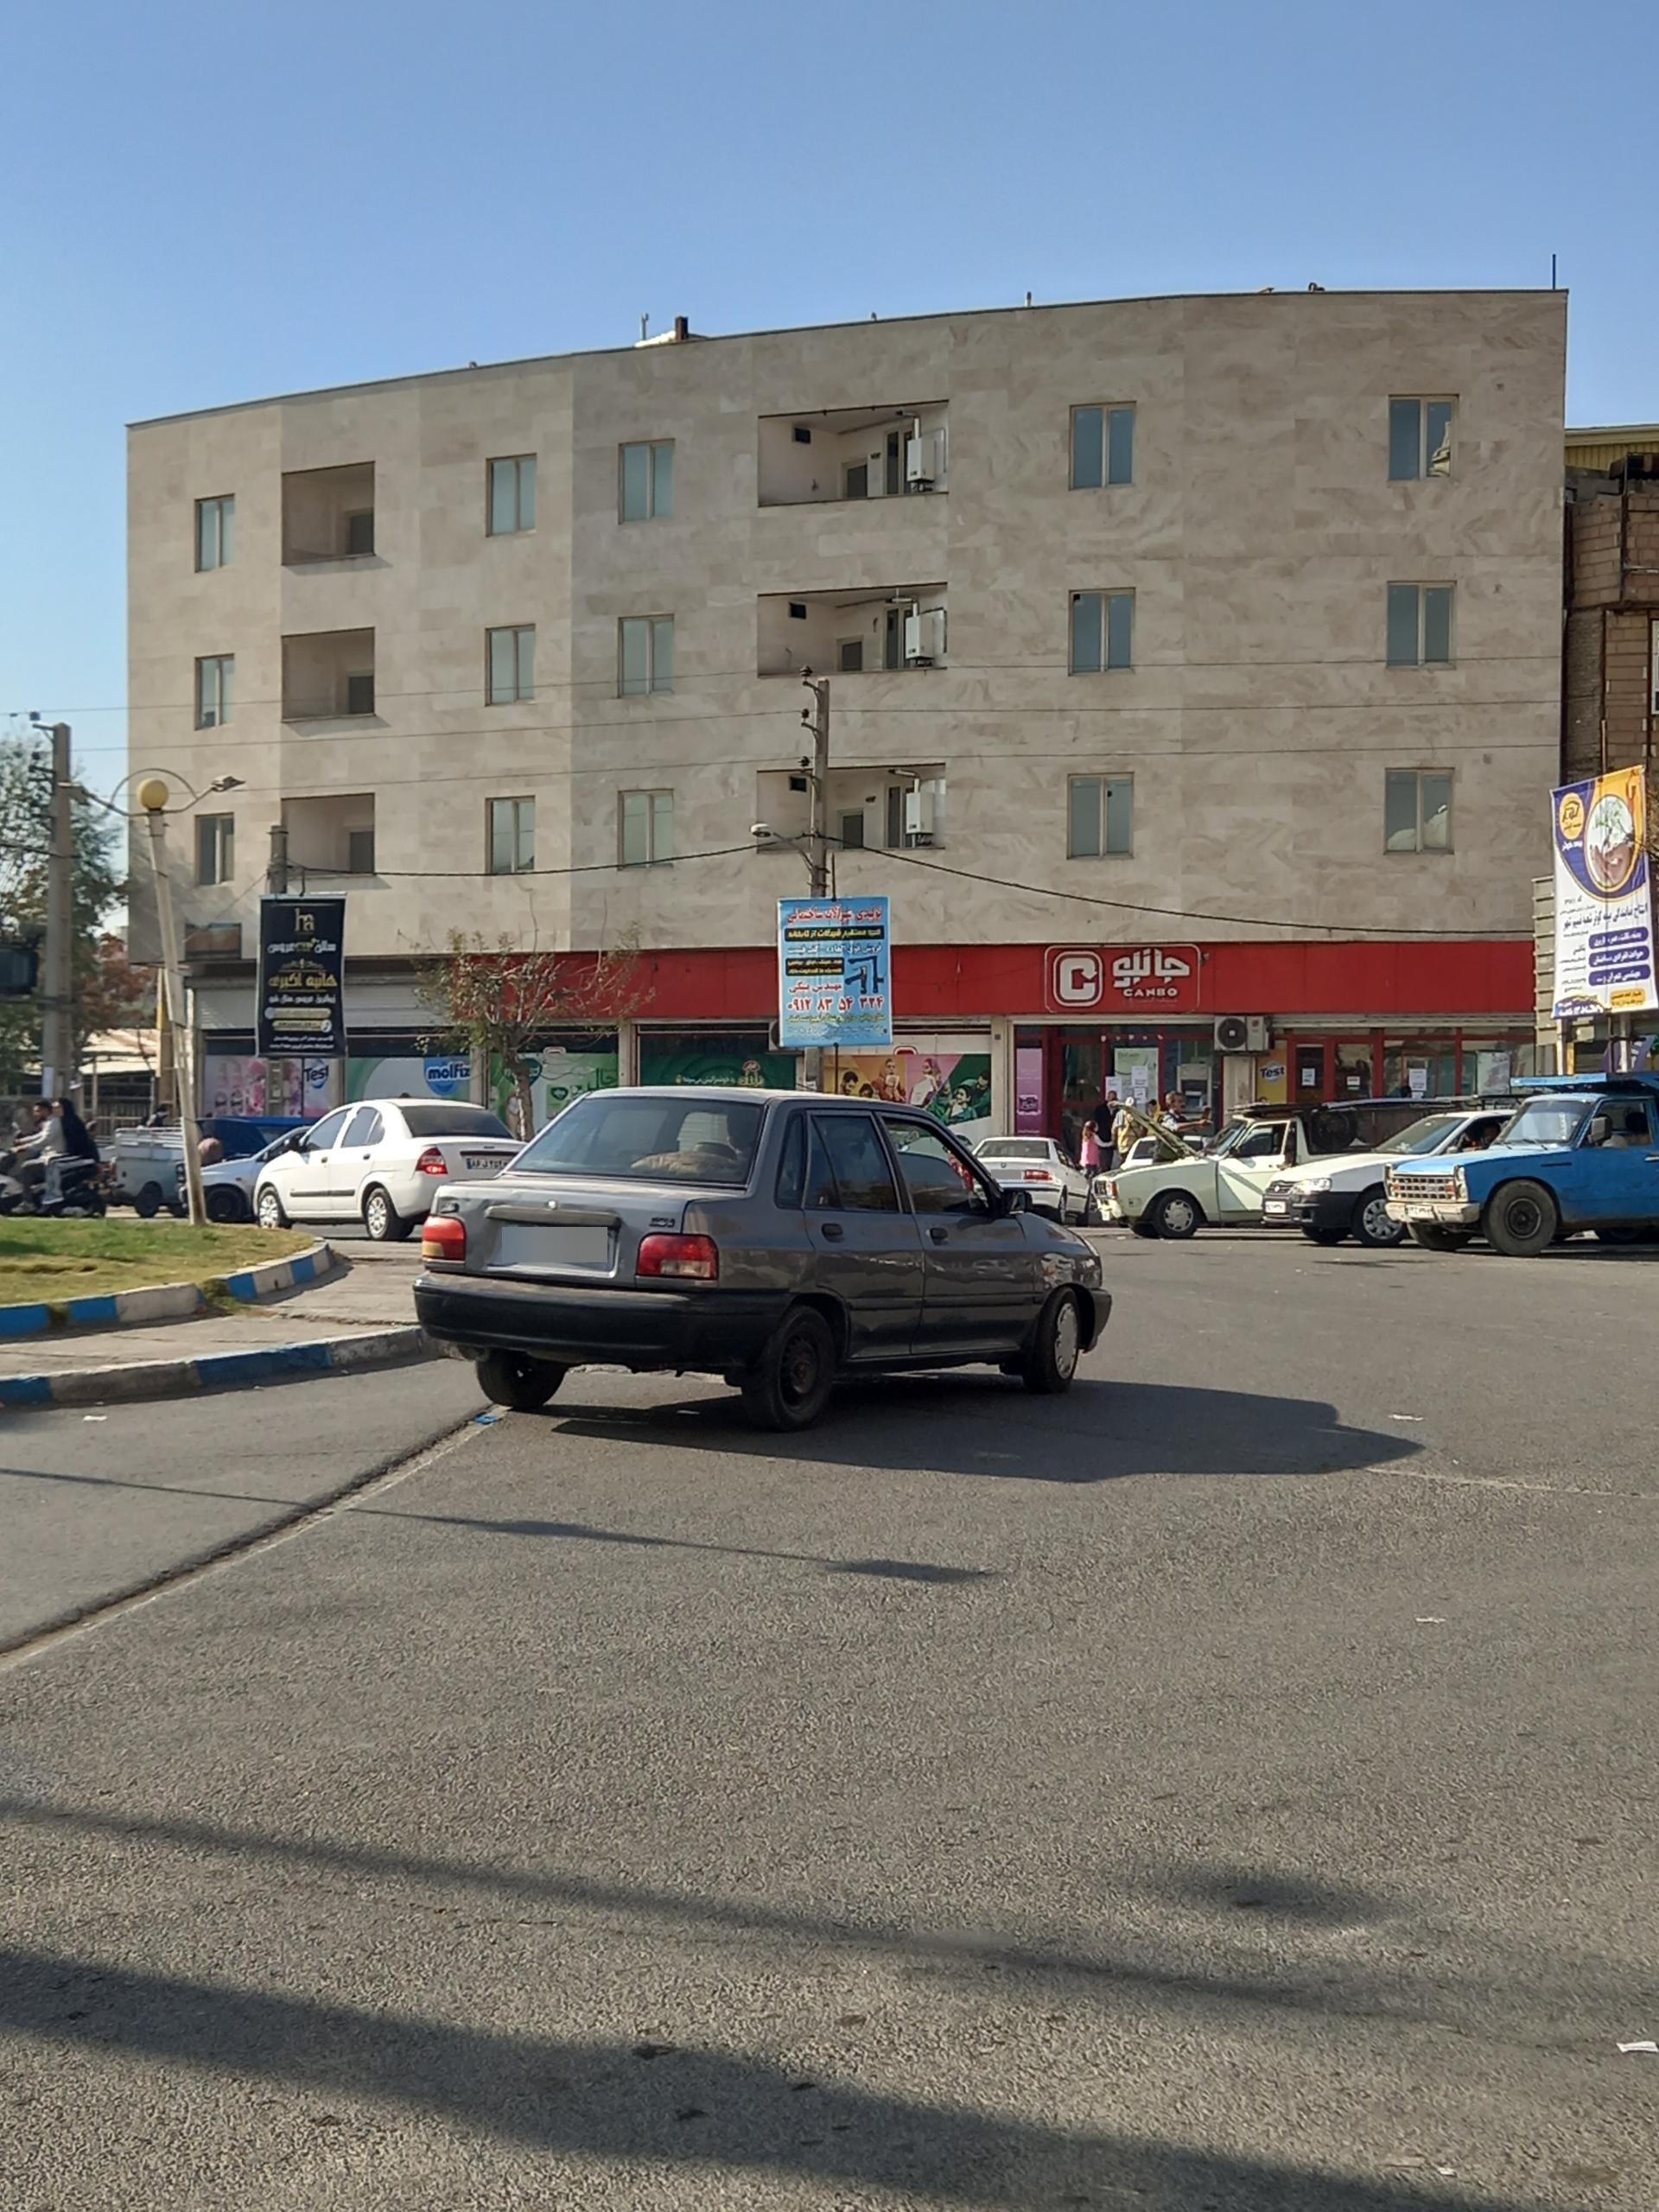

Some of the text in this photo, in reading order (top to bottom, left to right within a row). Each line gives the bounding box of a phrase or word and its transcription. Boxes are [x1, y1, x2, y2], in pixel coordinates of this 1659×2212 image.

[1112, 948, 1190, 988] جانبو
[1123, 988, 1178, 997] CANBO
[303, 1065, 328, 1082] Test
[1260, 1065, 1285, 1079] Test
